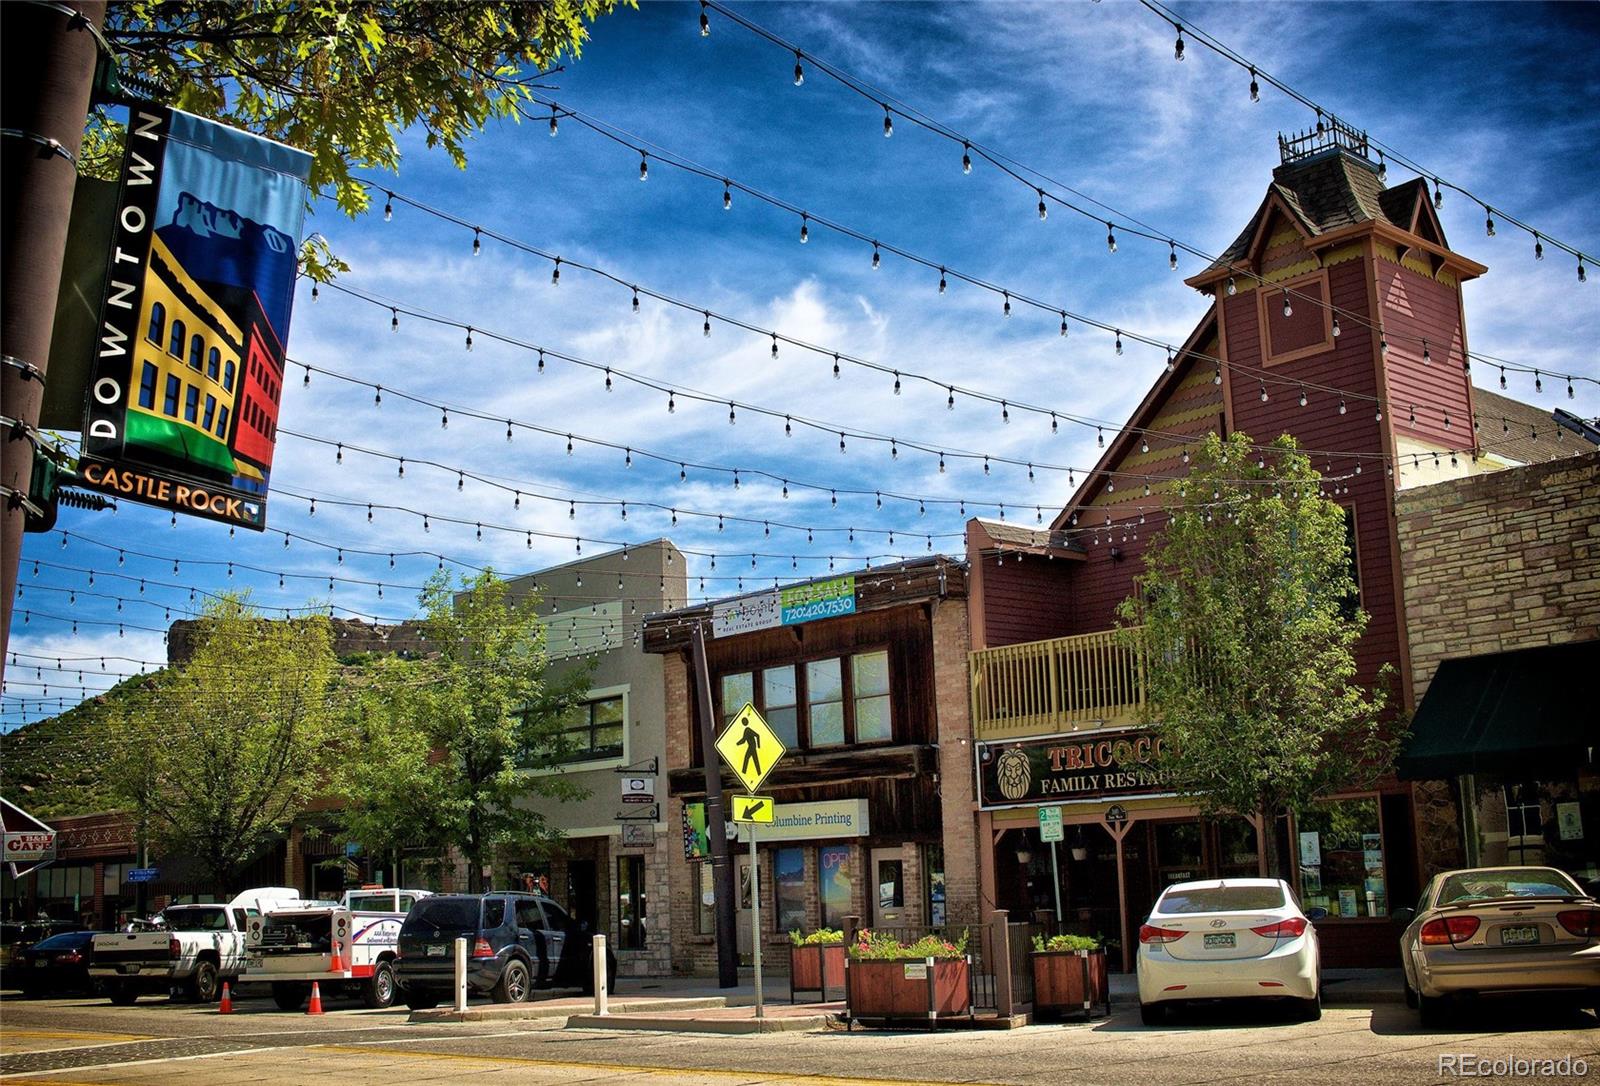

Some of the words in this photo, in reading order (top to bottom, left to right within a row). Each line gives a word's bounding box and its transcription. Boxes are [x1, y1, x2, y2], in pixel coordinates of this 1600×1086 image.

[89, 111, 162, 439] DOWNTOWN
[84, 463, 171, 501] CASTLE
[176, 486, 242, 519] ROCK
[1040, 774, 1100, 794] FAMILY
[765, 813, 812, 828] olumbine
[815, 812, 852, 827] Printing
[7, 839, 53, 851] CAFE
